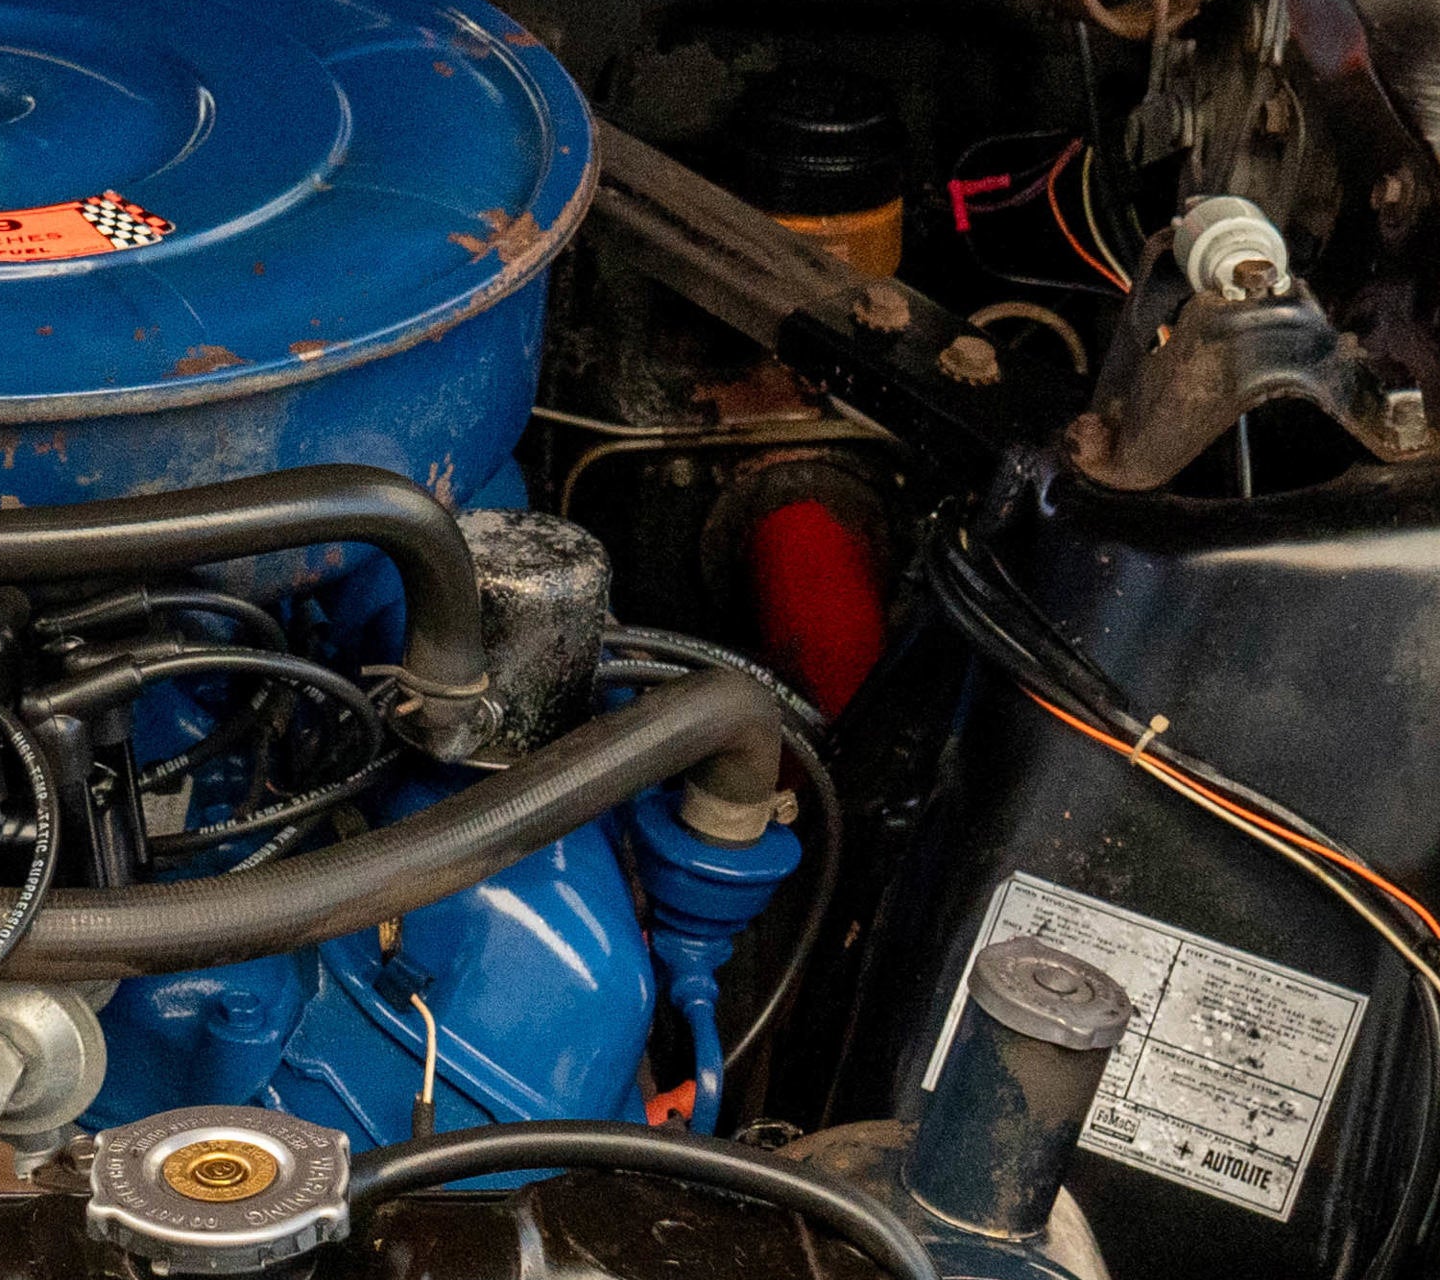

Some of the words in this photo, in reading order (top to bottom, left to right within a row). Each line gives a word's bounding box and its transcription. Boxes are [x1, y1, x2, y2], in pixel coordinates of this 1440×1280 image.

[12, 730, 36, 766] HIGH
[28, 765, 48, 800] TEMP
[35, 808, 51, 853] STATIC
[1199, 1147, 1274, 1191] AUTOLITE
